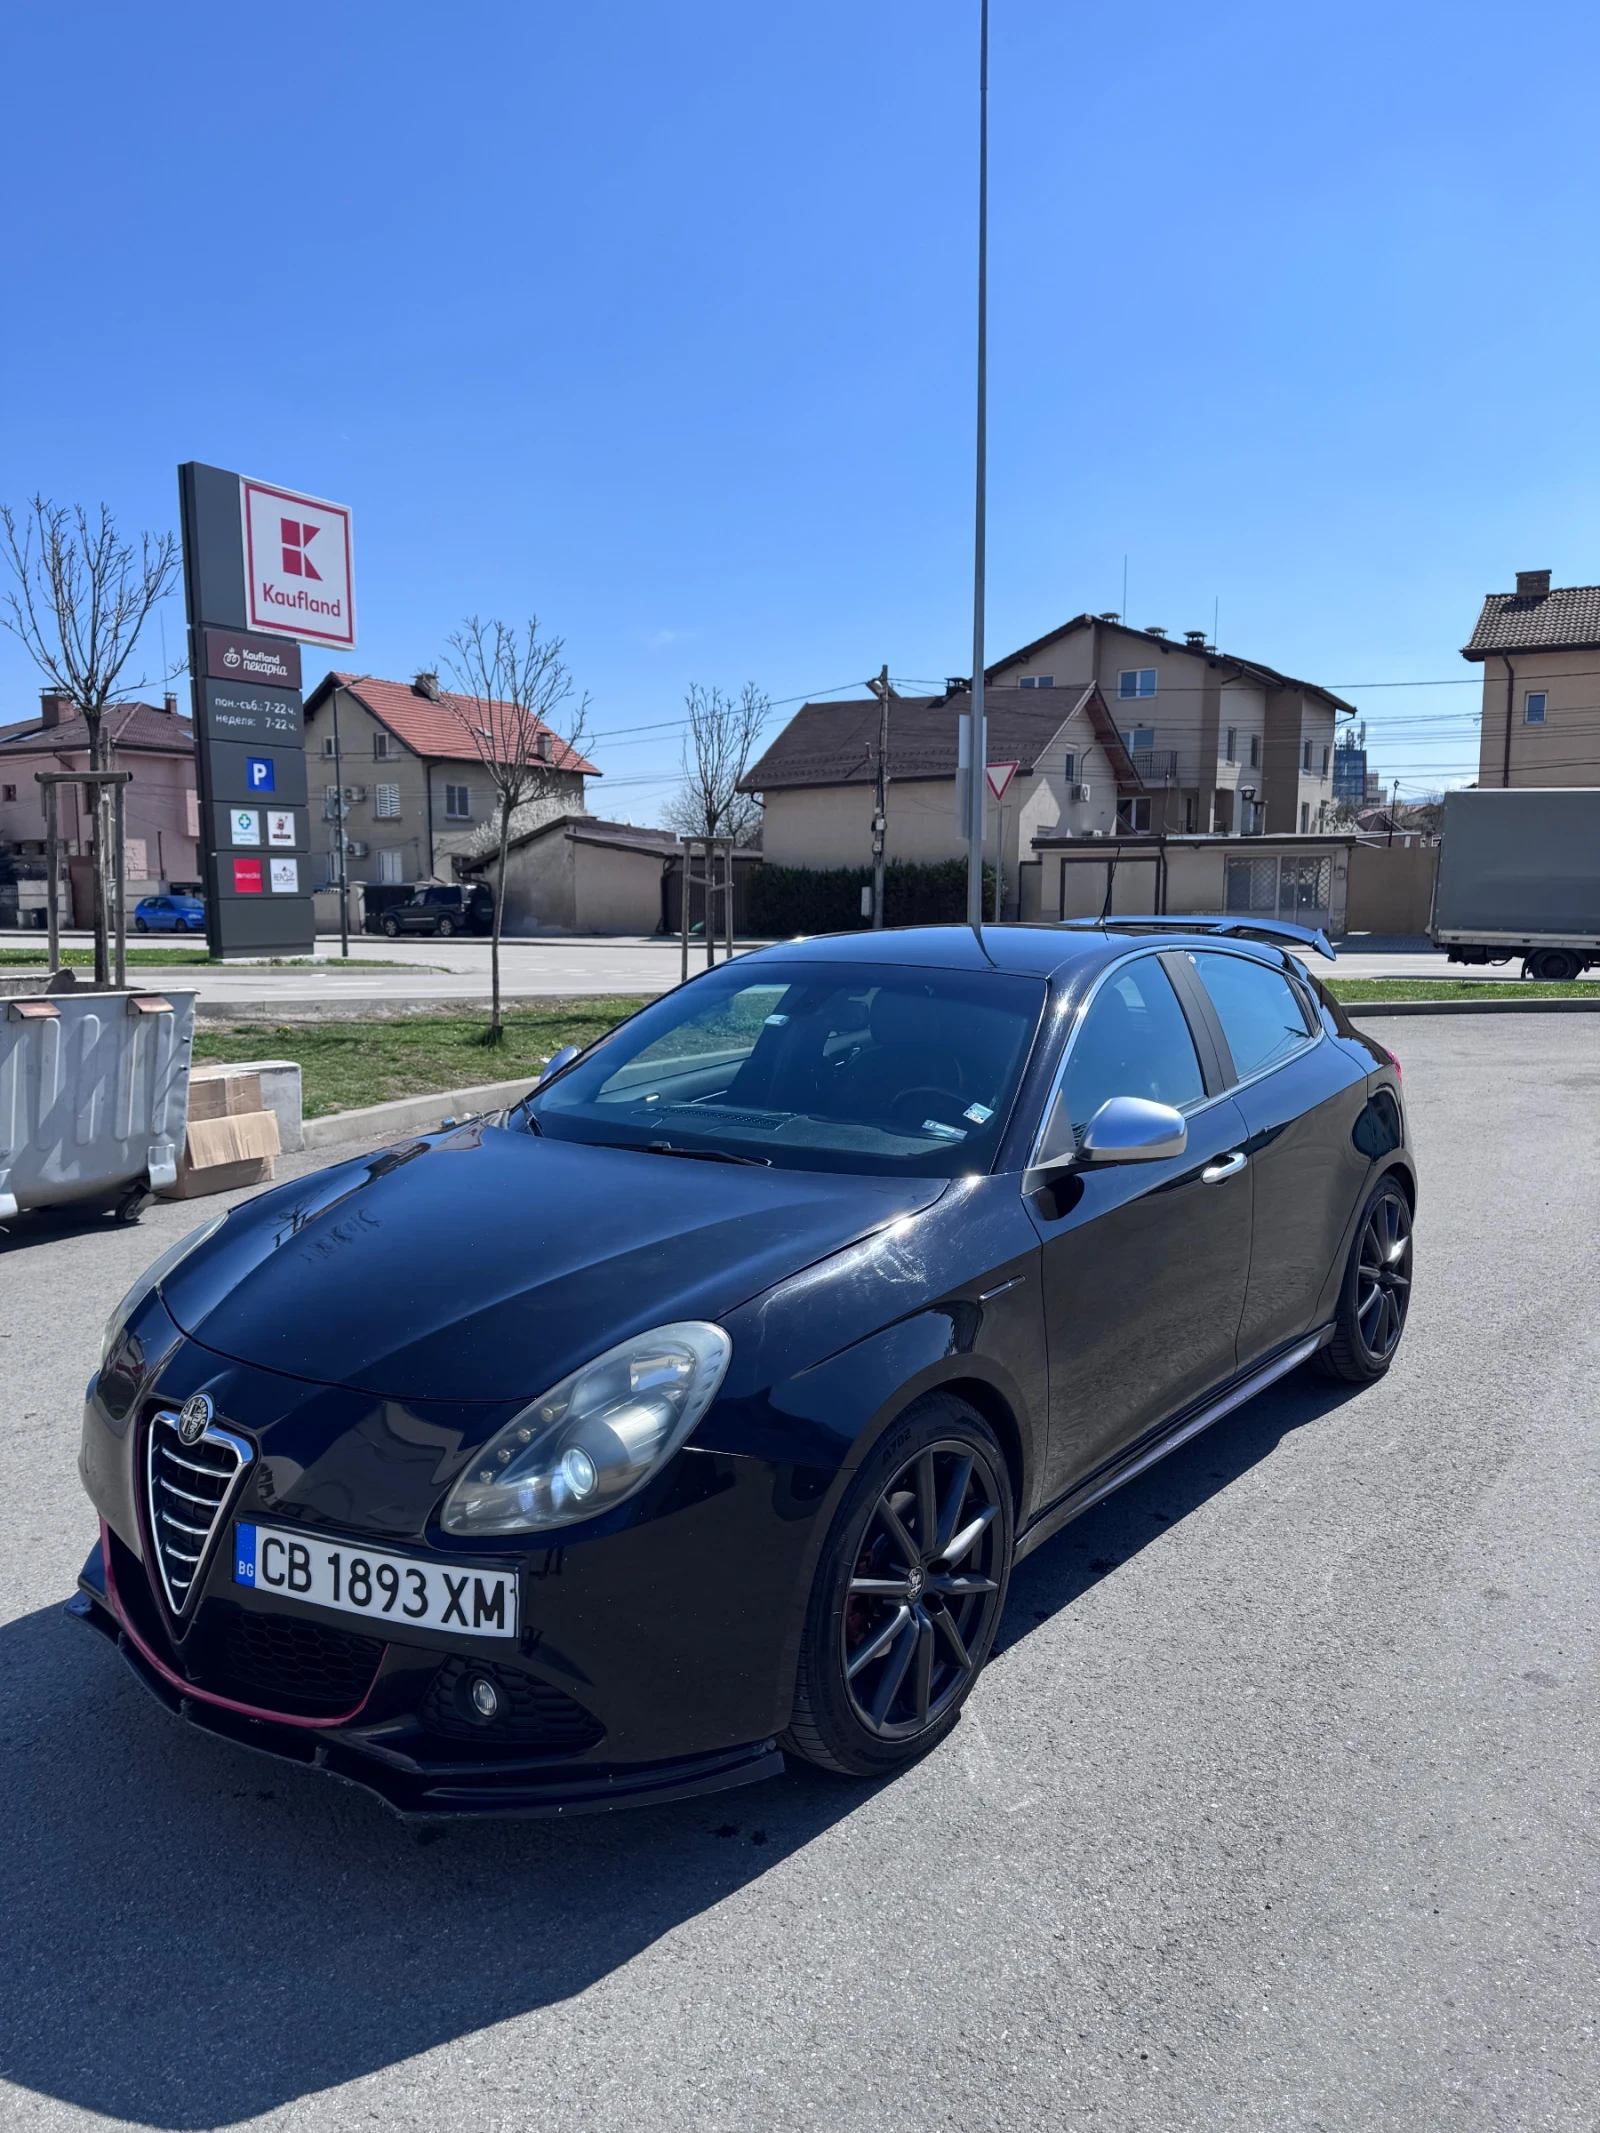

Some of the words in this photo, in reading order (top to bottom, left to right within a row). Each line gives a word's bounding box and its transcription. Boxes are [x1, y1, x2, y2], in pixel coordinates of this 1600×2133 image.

[262, 582, 341, 617] Kaufland
[242, 649, 280, 664] Kaufland
[242, 660, 288, 676] пекарна
[264, 701, 287, 715] 7-22
[287, 707, 297, 715] ч.
[215, 714, 256, 727] неделя:
[265, 717, 288, 730] 7-22
[288, 723, 298, 731] ч.
[252, 763, 267, 785] P
[238, 1560, 254, 1577] BG
[261, 1537, 312, 1594] CB
[327, 1552, 429, 1619] 1893
[440, 1572, 505, 1630] XM
